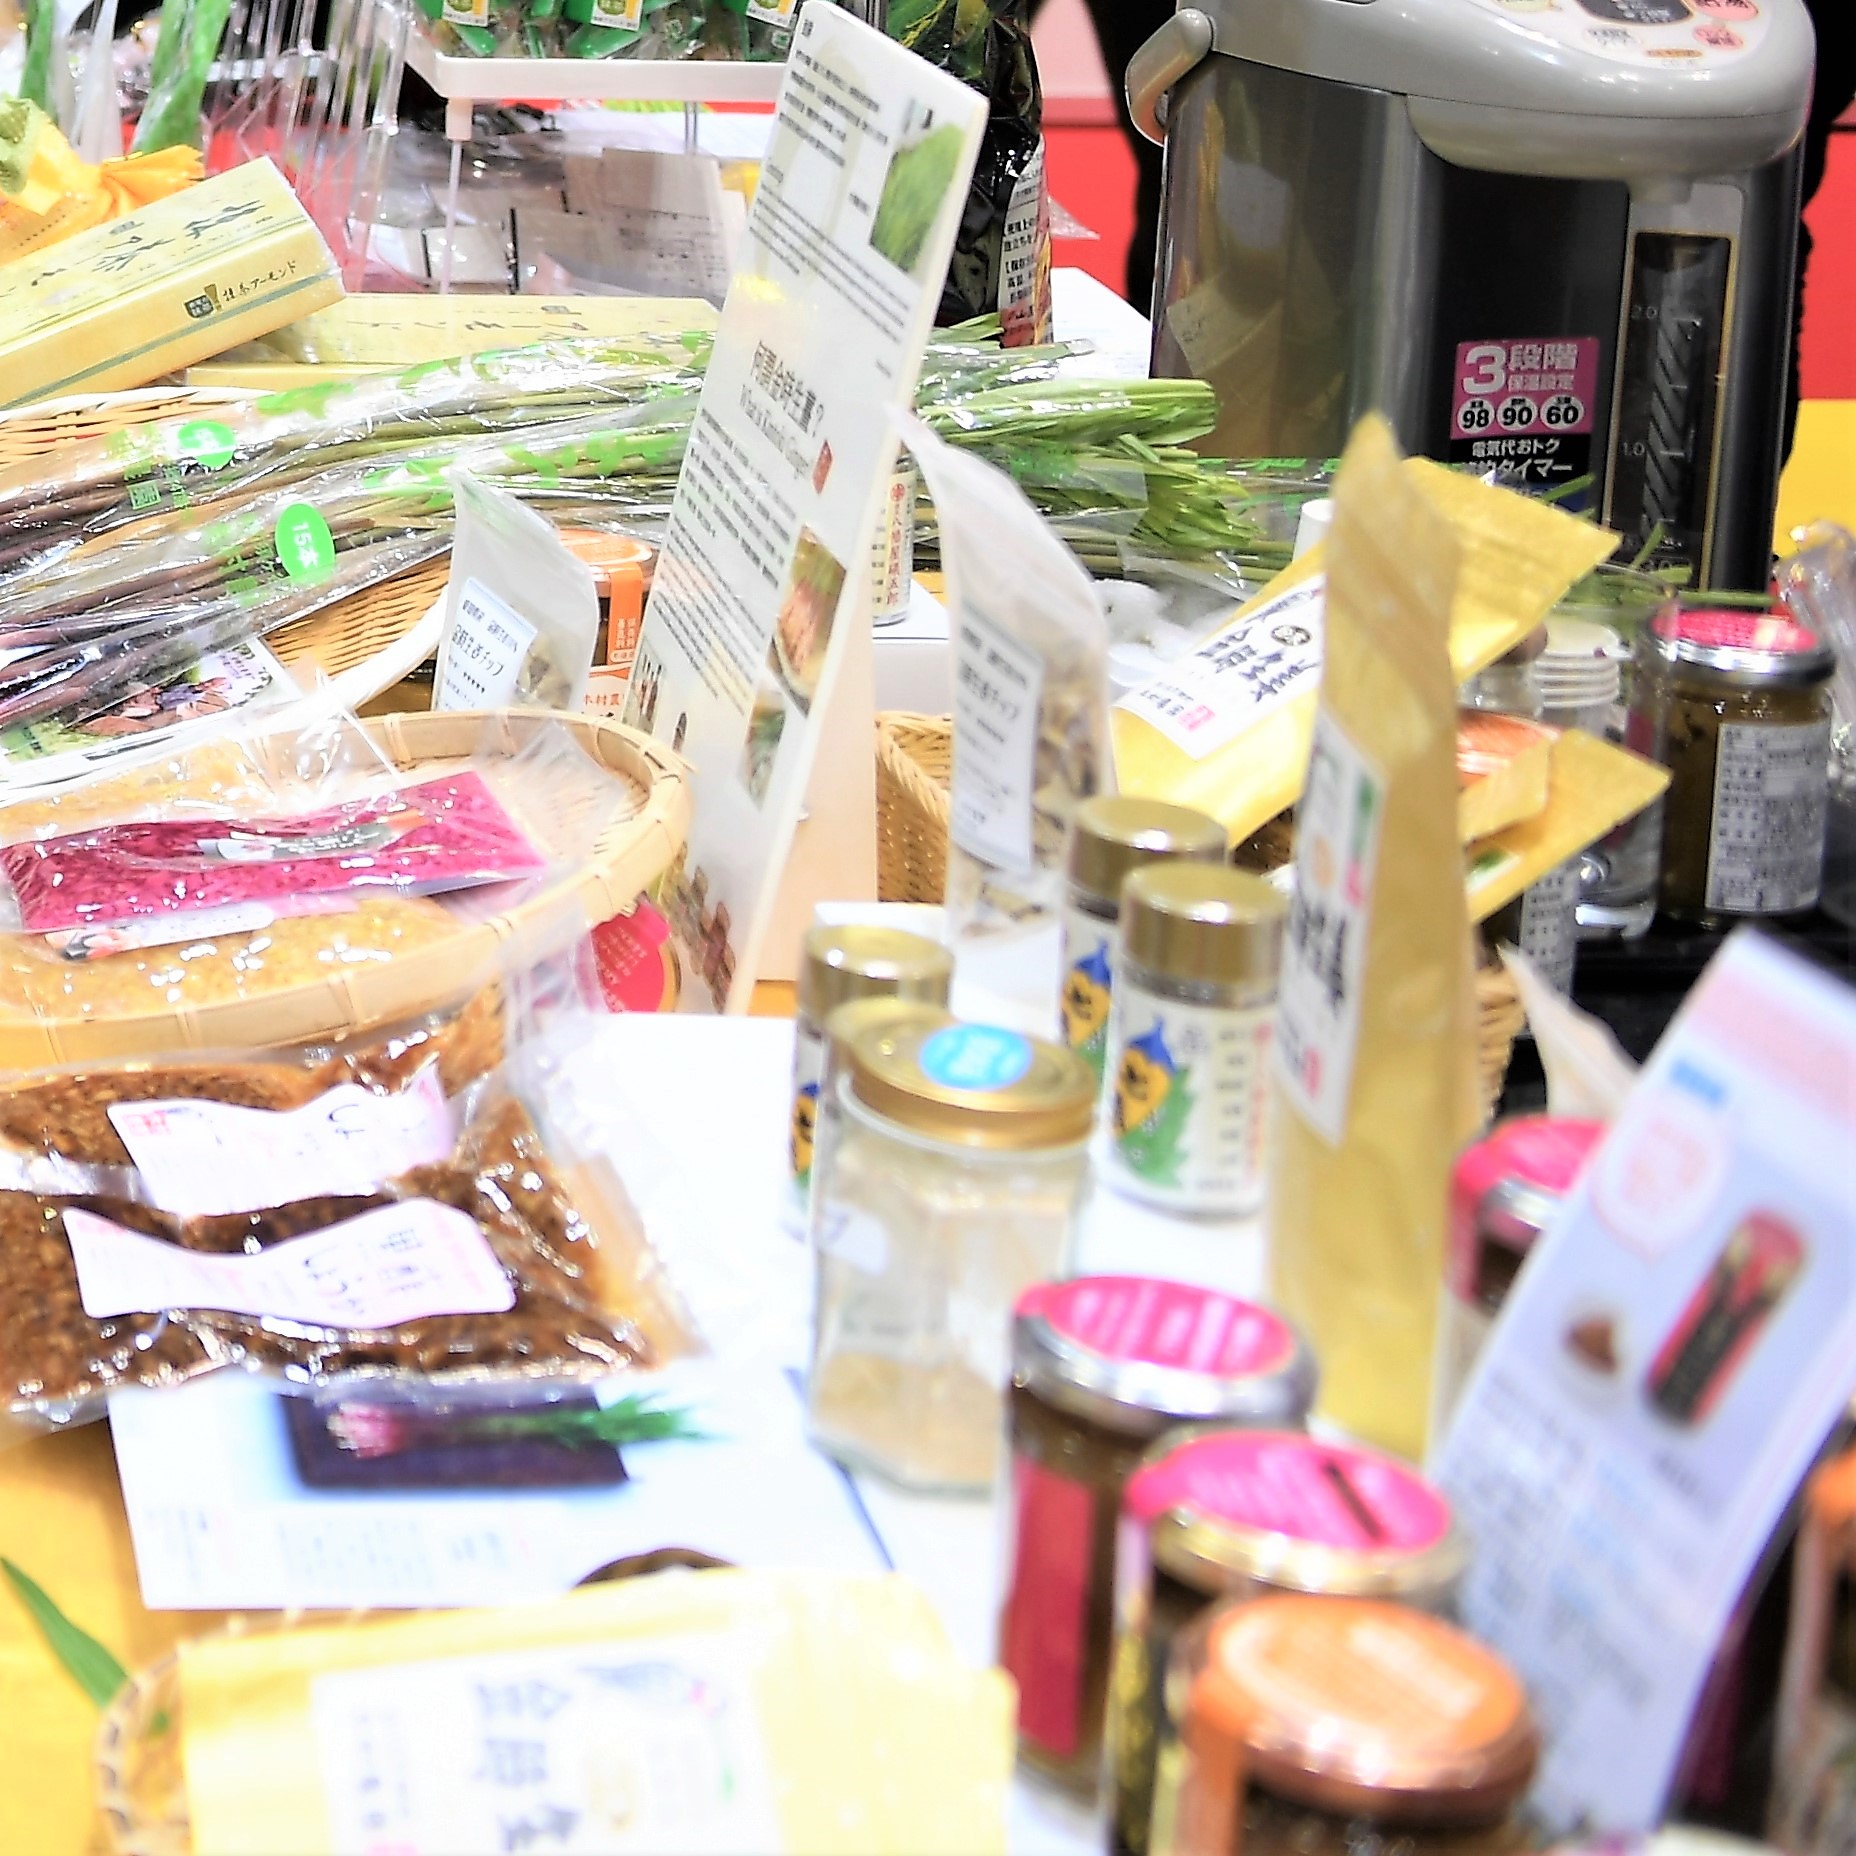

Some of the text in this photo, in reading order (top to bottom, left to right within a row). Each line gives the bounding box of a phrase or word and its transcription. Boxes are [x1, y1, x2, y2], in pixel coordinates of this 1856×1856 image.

[1462, 405, 1580, 430] 98 90 60
[1472, 438, 1561, 458] 電気代おトク
[292, 521, 321, 569] 15本
[583, 693, 626, 707] 木村農
